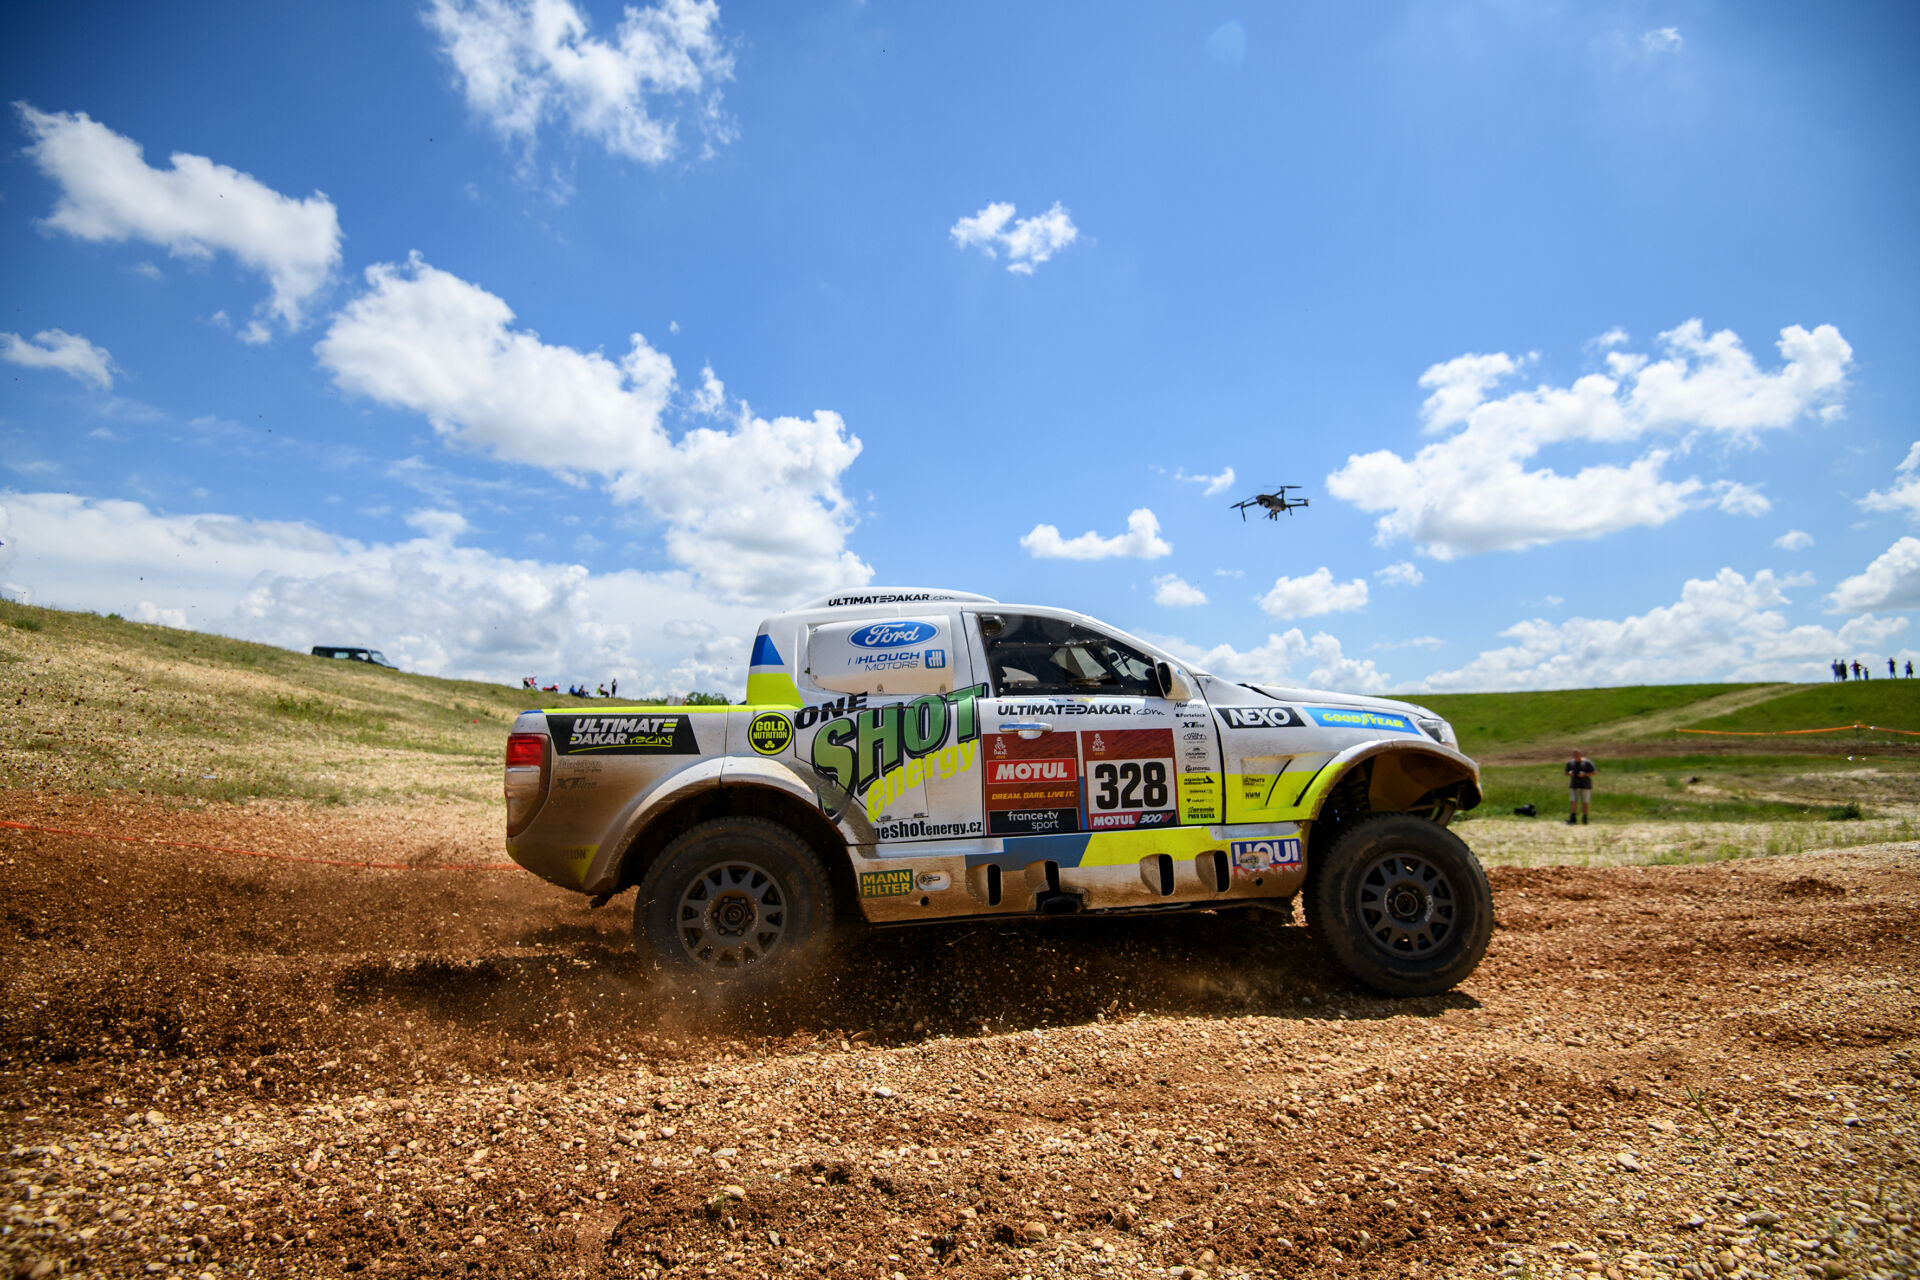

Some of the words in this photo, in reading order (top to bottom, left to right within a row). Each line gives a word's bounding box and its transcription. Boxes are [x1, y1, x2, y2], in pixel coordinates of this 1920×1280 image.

[865, 624, 920, 645] Ford
[865, 660, 918, 671] MOTORS
[794, 692, 868, 730] ONE
[1228, 709, 1292, 727] NEXO
[572, 718, 679, 733] ULTIMATE
[569, 733, 628, 745] DAKAR
[630, 732, 673, 747] racing
[753, 731, 788, 740] NUTRITION
[811, 682, 989, 825] SHOT
[995, 762, 1068, 780] MOTUL
[866, 738, 979, 824] energy
[1095, 762, 1168, 810] 328
[1031, 820, 1059, 832] sport
[1093, 815, 1135, 826] MOTUL
[1139, 812, 1173, 823] 300V
[874, 821, 983, 840] neshotenergy.cz
[863, 872, 910, 885] MANN
[863, 882, 911, 896] FILTER
